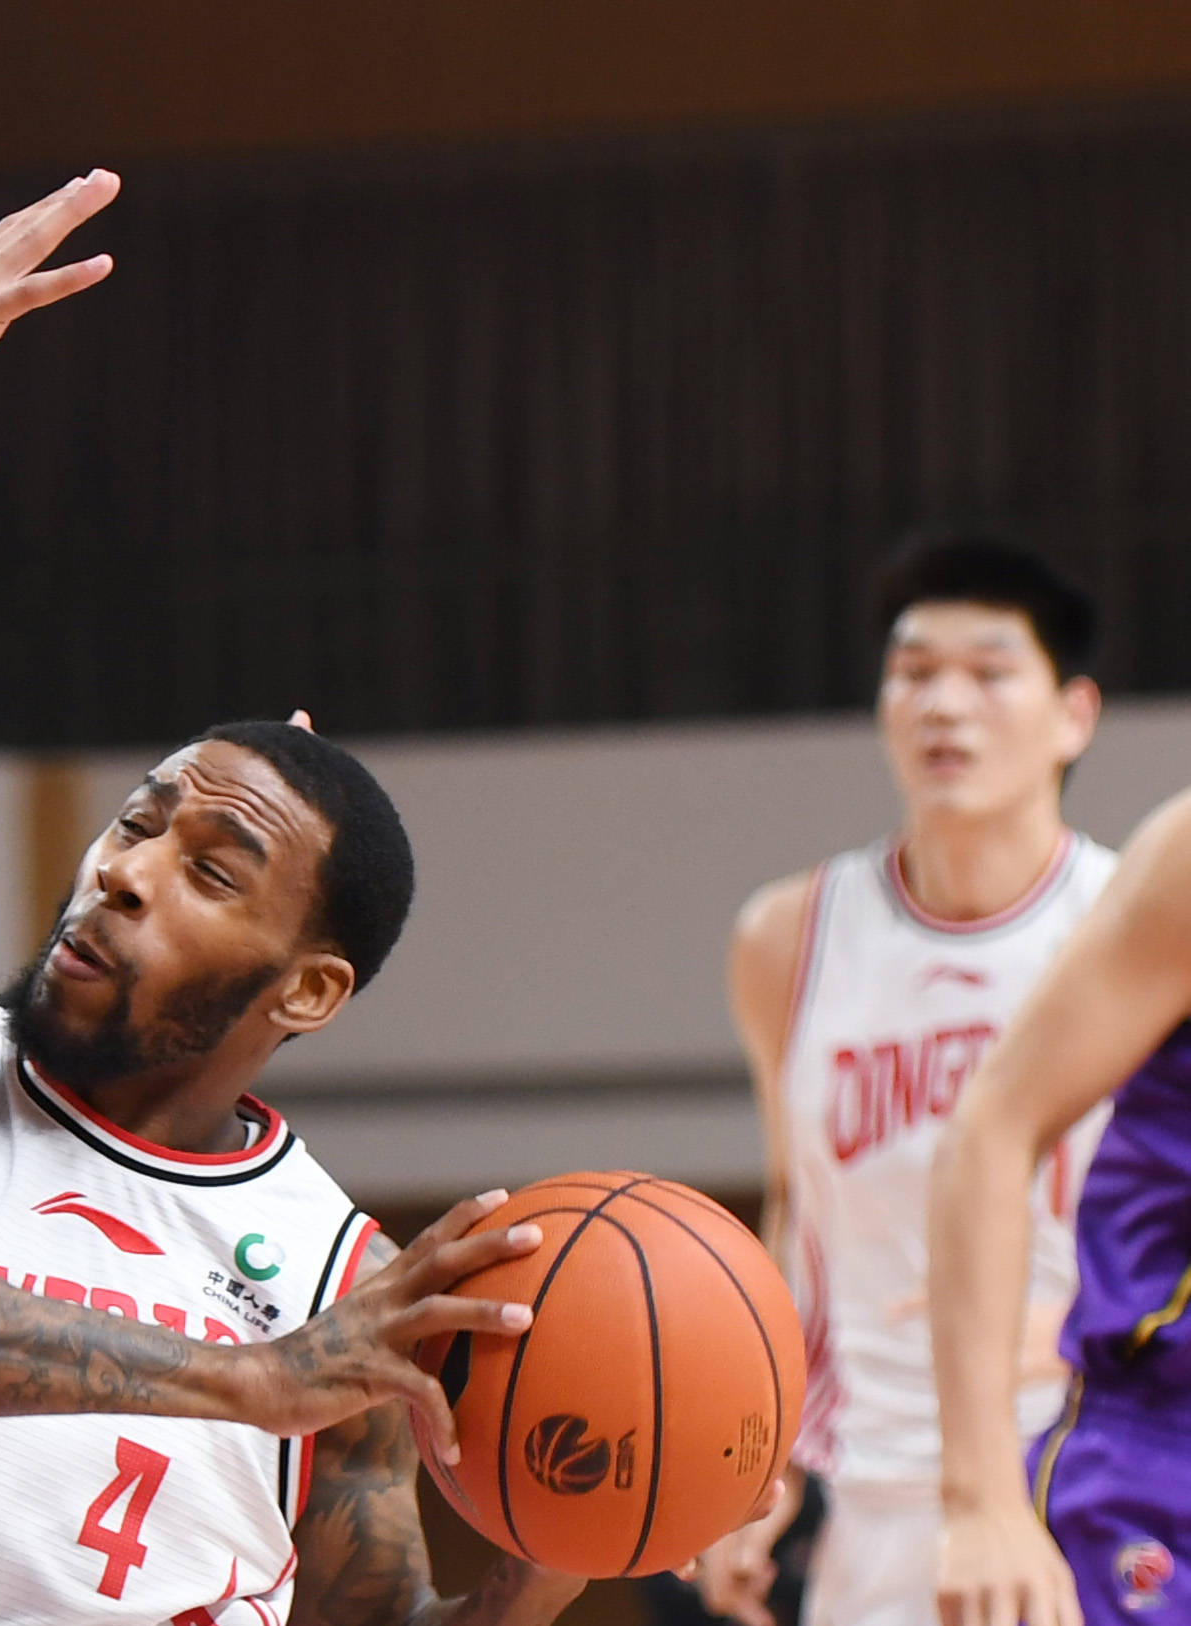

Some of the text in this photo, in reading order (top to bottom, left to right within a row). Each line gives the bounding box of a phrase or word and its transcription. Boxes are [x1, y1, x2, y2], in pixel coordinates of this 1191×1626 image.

[202, 1286, 271, 1335] CHINA LIFE
[77, 1436, 171, 1601] 4
